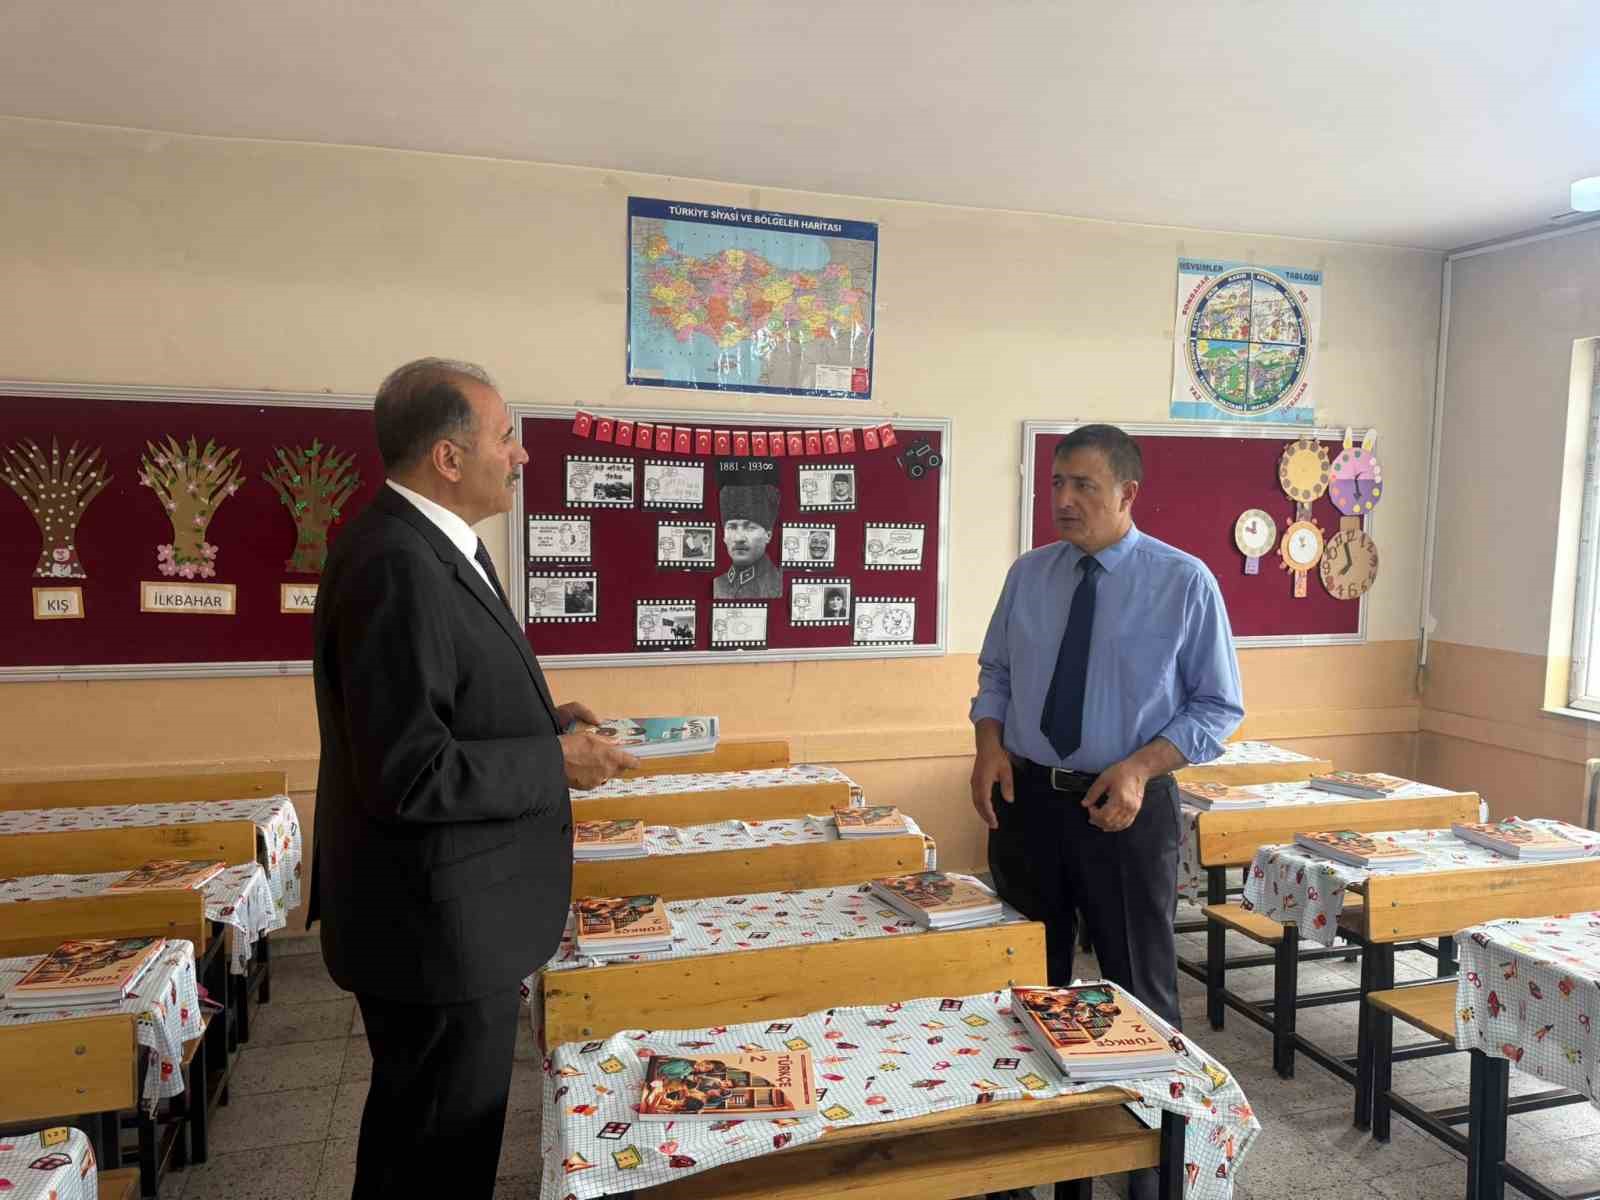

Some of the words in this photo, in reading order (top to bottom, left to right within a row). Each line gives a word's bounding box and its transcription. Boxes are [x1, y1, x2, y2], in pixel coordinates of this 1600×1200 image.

[669, 205, 709, 218] TÜRKİYE
[711, 208, 739, 222] SİYASİ
[741, 214, 753, 223] VE
[754, 213, 799, 229] BÖLGELER
[801, 219, 843, 232] HARİTASI
[720, 462, 738, 471] 1881
[1348, 582, 1358, 597] 6
[47, 599, 69, 613] KIŞ
[154, 590, 223, 608] İLKBAHAR
[1131, 1024, 1146, 1033] 2
[1095, 1036, 1157, 1048] TÜRKÇE
[750, 1055, 767, 1063] 2
[776, 1054, 792, 1088] TÜRKÇE
